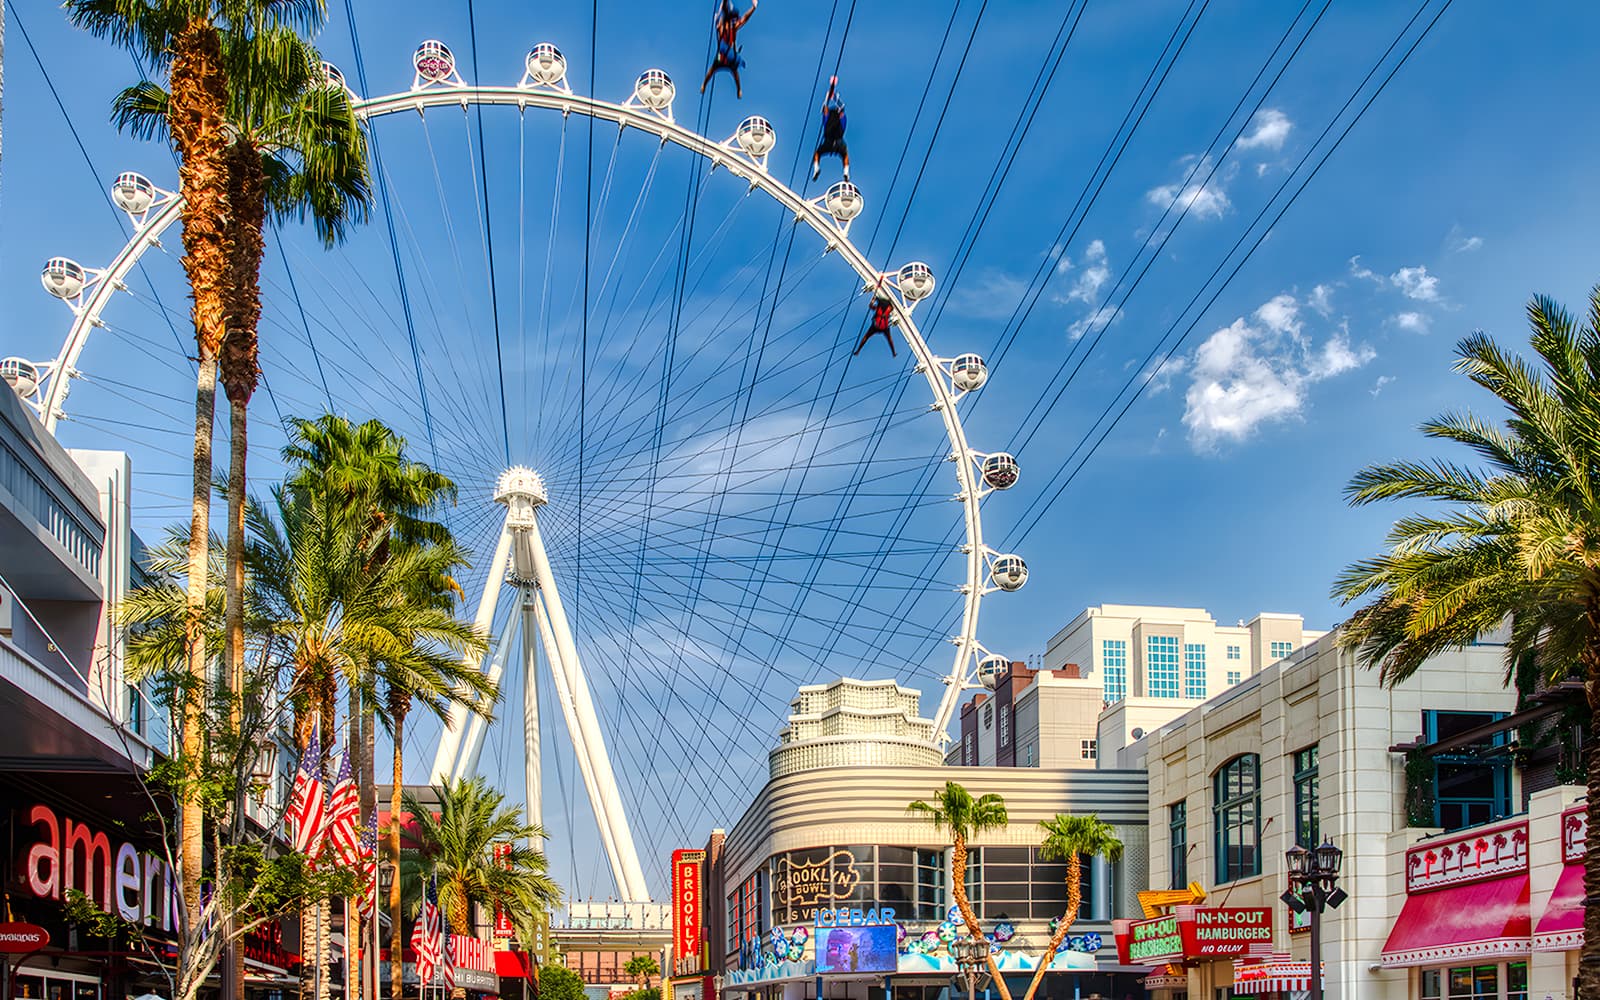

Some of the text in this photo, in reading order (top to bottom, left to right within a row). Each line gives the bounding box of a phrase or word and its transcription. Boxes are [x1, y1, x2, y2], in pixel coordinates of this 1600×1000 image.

[780, 867, 850, 893] BROOKLYN
[795, 882, 827, 894] BOWL
[781, 910, 798, 922] LS
[815, 907, 896, 927] ICEBAR
[1197, 912, 1264, 924] IN-N-OUT
[1134, 918, 1176, 940] IN-N-OU
[1197, 927, 1270, 940] HAMBURGERS
[1130, 935, 1182, 960] HAMBURGER
[1217, 944, 1243, 952] DELAY
